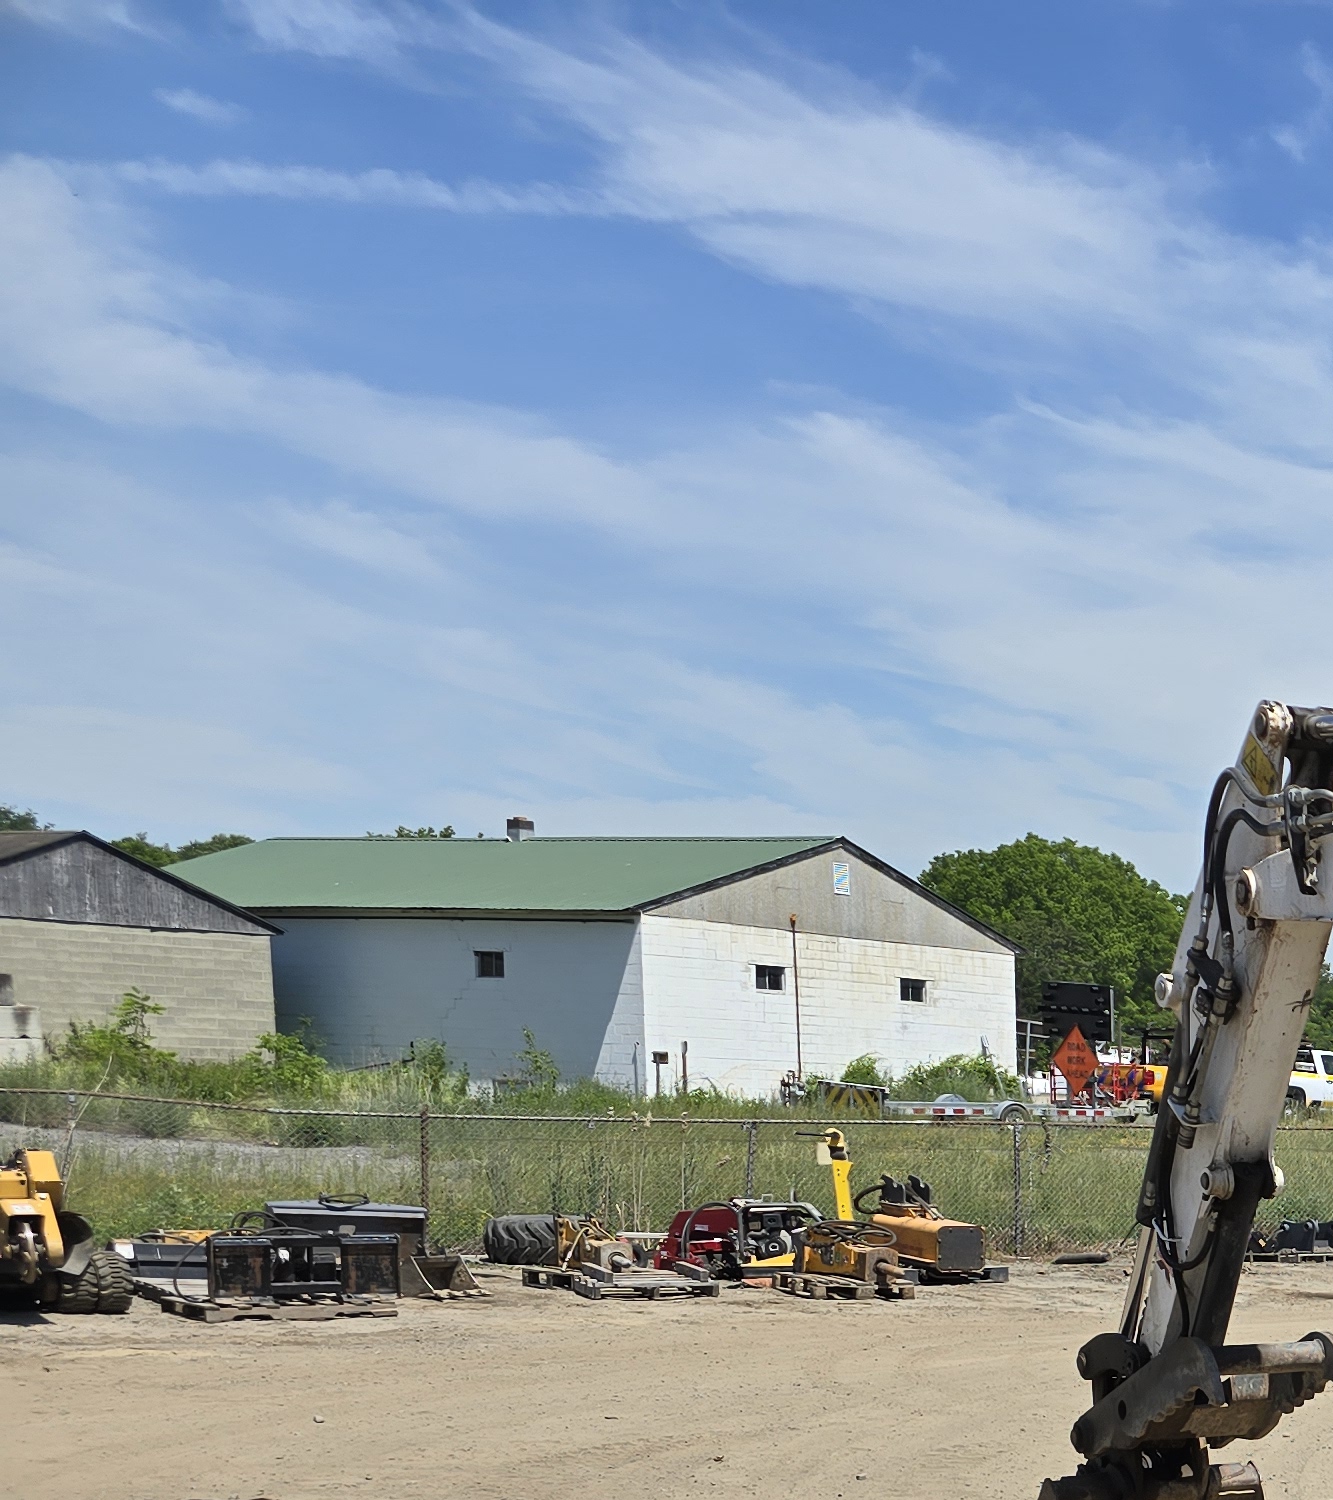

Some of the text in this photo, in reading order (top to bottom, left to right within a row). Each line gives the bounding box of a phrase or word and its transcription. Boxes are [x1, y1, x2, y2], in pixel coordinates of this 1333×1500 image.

[1067, 1042, 1086, 1052] ROAD
[1067, 1056, 1086, 1065] WORK
[1067, 1069, 1089, 1078] AHEAD
